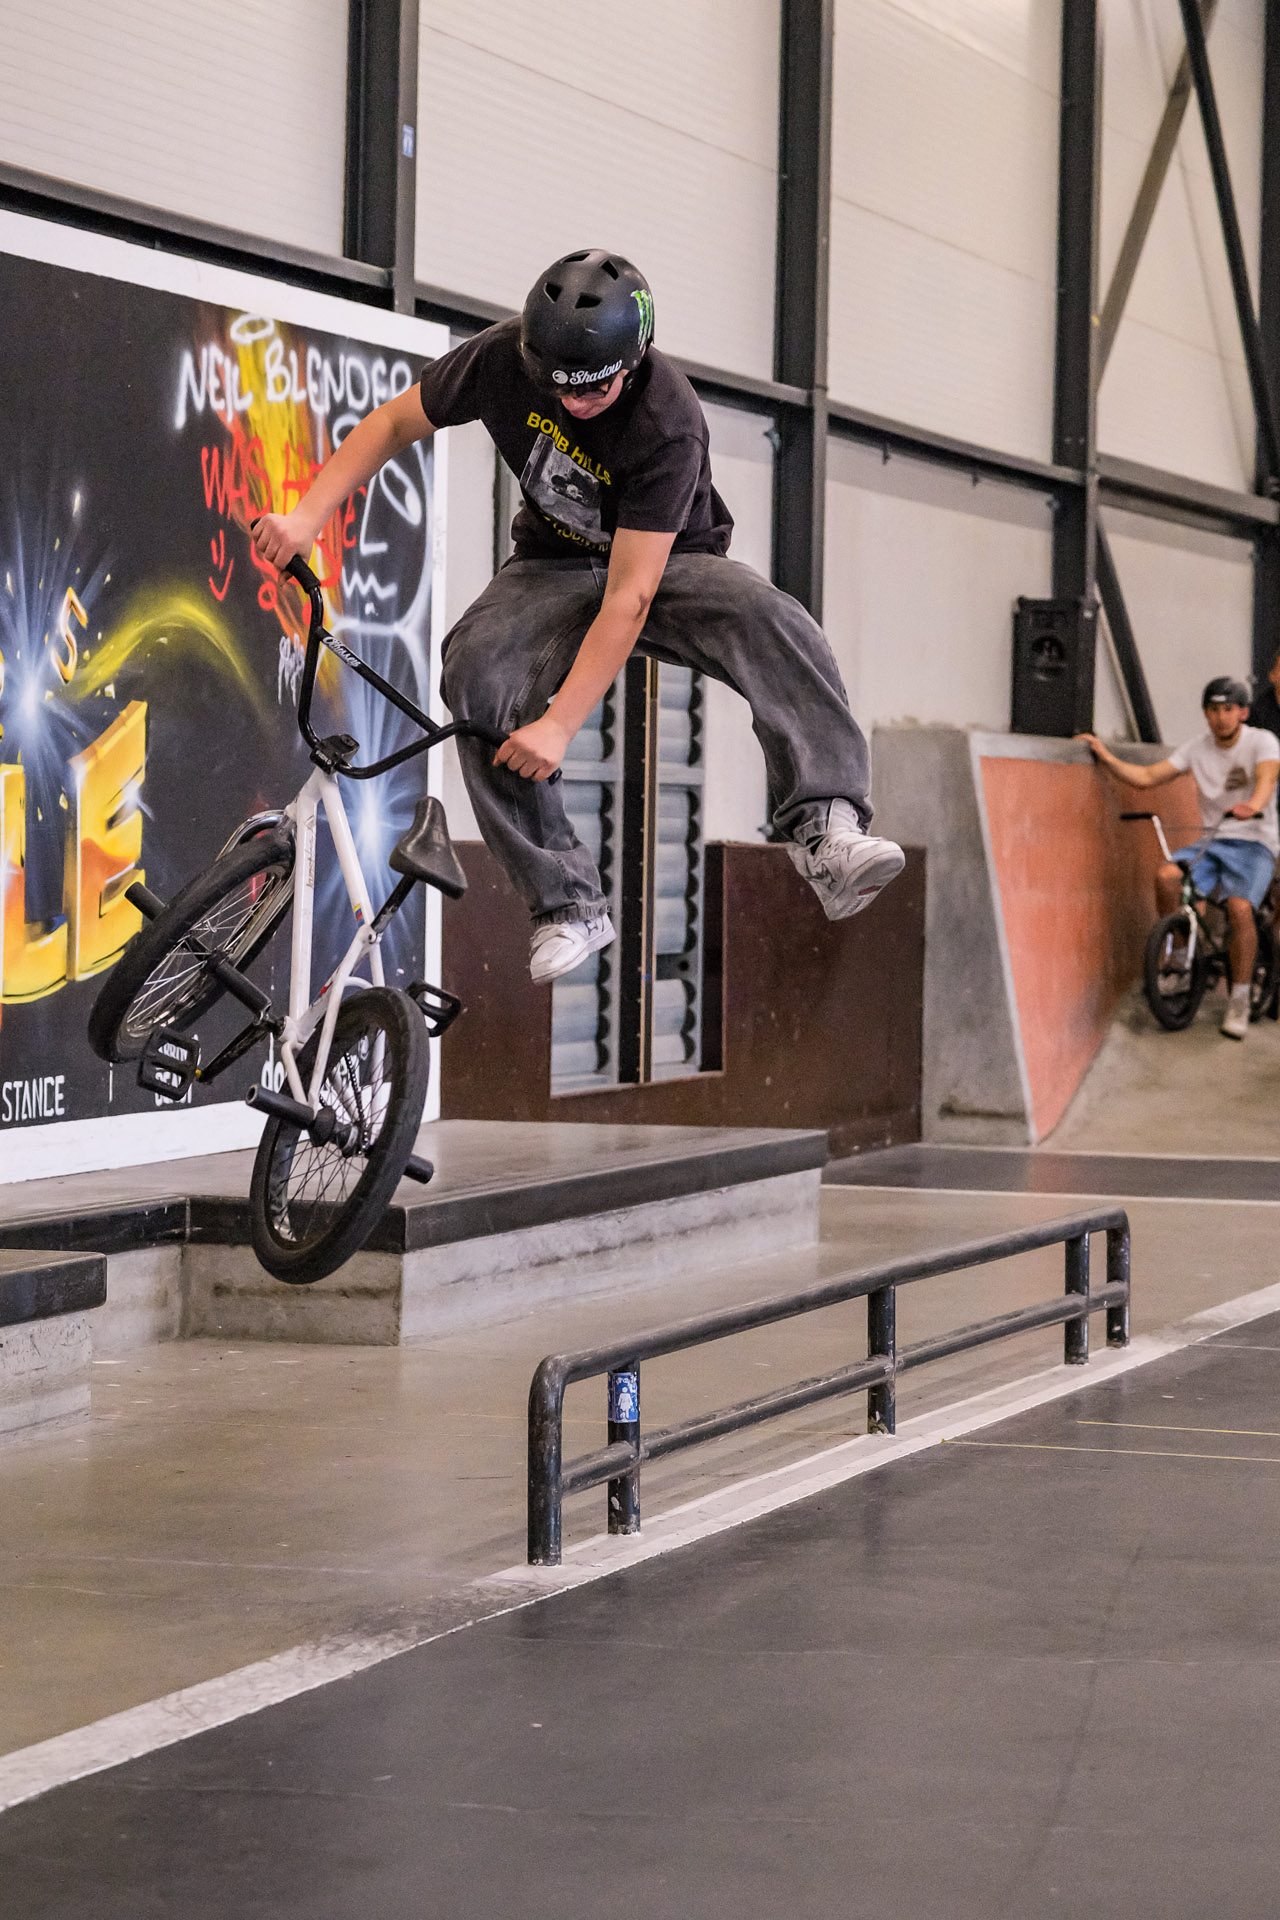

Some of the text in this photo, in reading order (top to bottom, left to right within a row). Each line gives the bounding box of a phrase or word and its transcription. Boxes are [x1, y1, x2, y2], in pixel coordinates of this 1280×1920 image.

[175, 342, 253, 430] NEIL
[569, 360, 623, 385] Shadow
[201, 432, 272, 521] WAS
[527, 411, 611, 485] BOMB HILLS
[2, 1075, 65, 1122] STANCE
